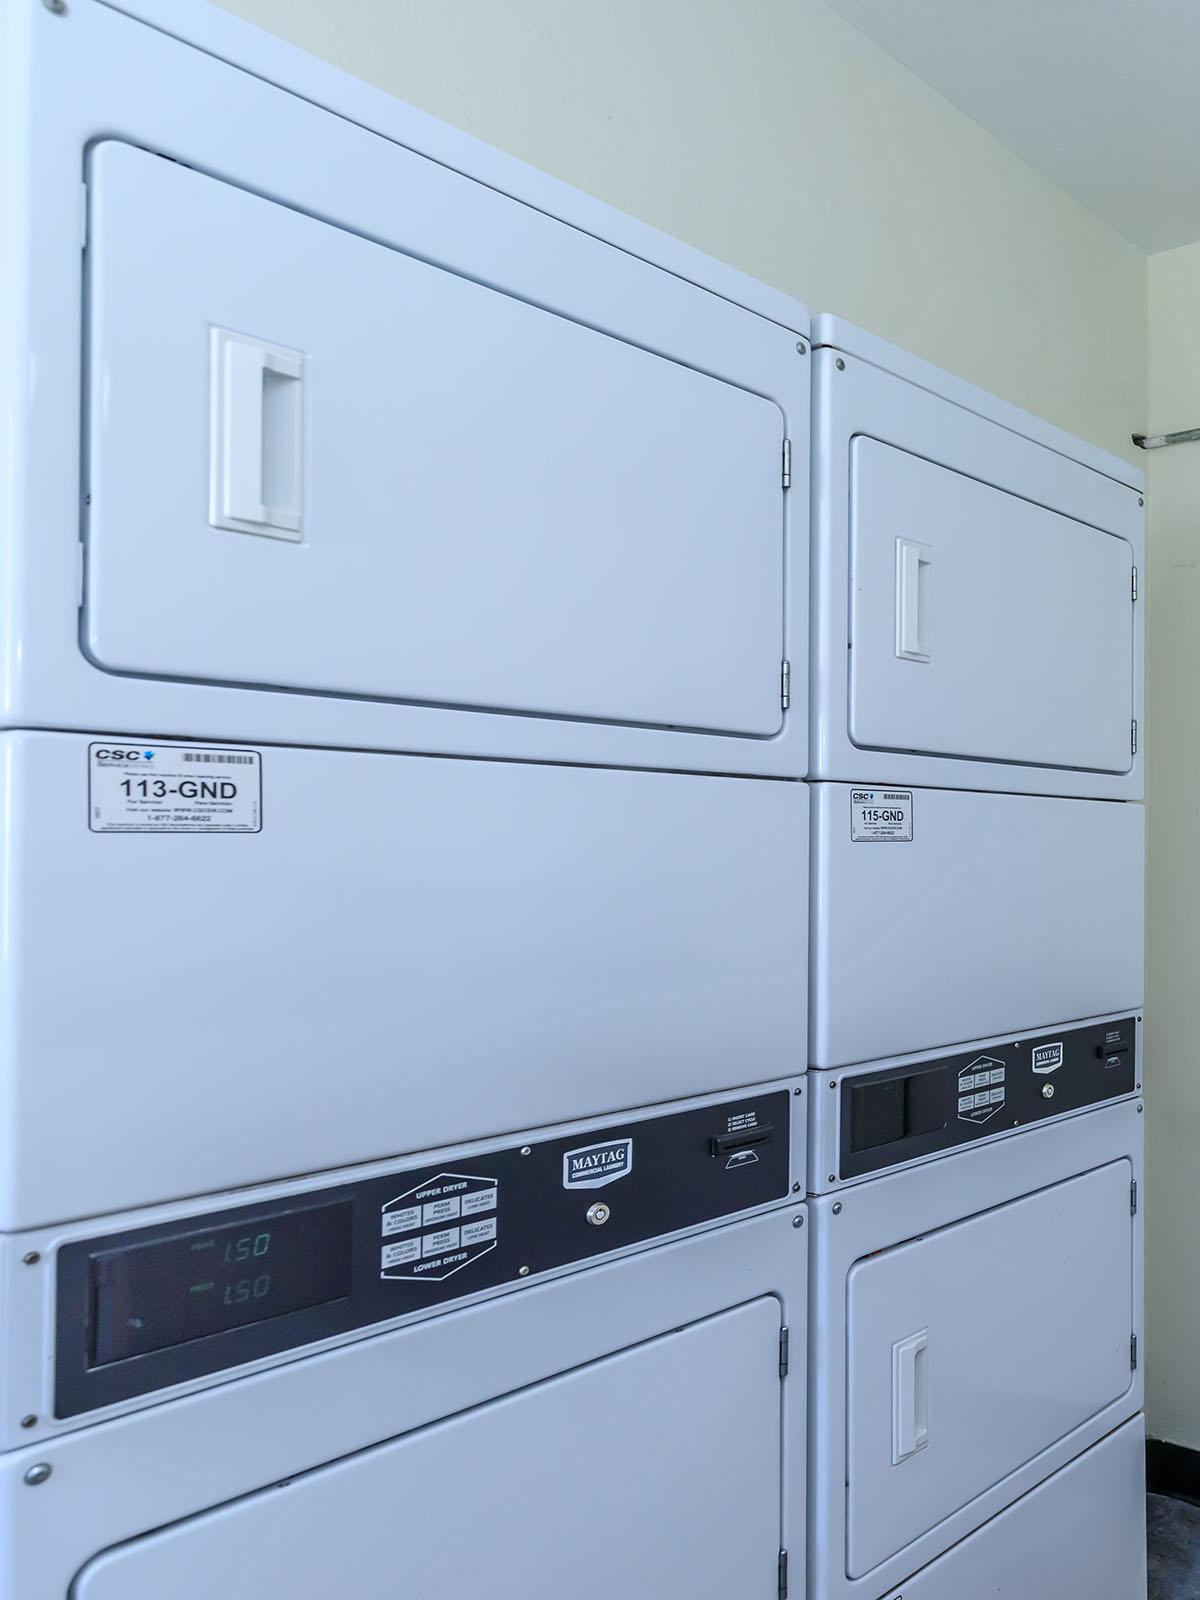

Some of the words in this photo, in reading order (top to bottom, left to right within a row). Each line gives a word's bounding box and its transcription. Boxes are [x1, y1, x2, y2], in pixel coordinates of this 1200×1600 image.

[96, 750, 140, 760] CSC
[121, 779, 237, 799] 113-GND
[862, 810, 903, 821] 115-GND
[1036, 1049, 1059, 1062] MAYTAG
[572, 1148, 624, 1171] MAYTAG
[572, 1166, 603, 1178] COMMERCIAL
[604, 1162, 624, 1172] LAUNDRY
[416, 1188, 441, 1199] UPPER
[443, 1182, 467, 1193] DRYER
[393, 1215, 417, 1225] COLORS
[414, 1260, 441, 1273] LOWER
[443, 1252, 467, 1265] DRYER
